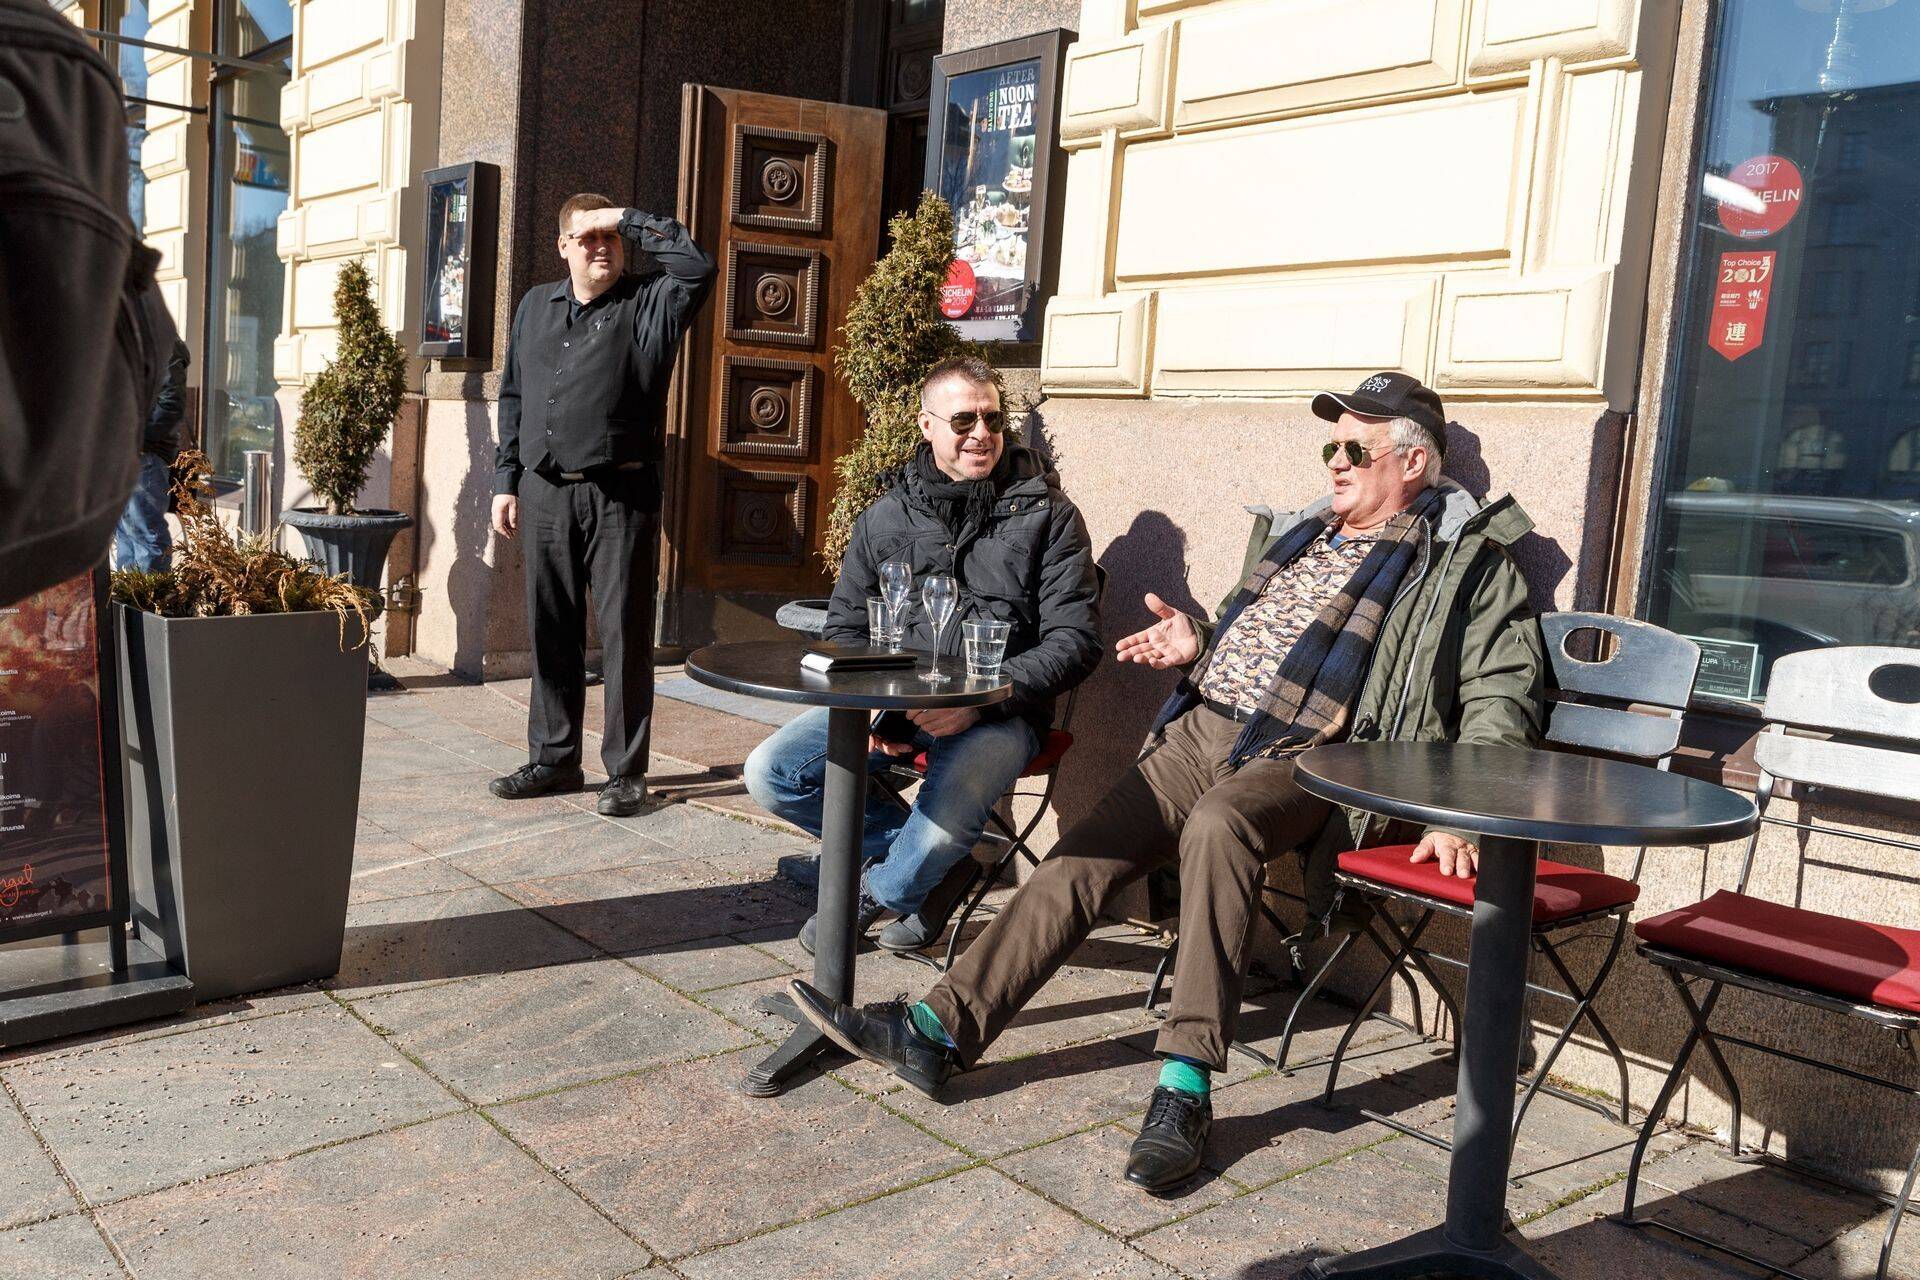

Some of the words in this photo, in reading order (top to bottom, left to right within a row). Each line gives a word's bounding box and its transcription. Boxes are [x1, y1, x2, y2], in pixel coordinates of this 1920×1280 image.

[999, 68, 1035, 86] AFTER
[999, 83, 1035, 106] NOON
[997, 102, 1033, 131] TEA
[1746, 162, 1780, 176] 2017
